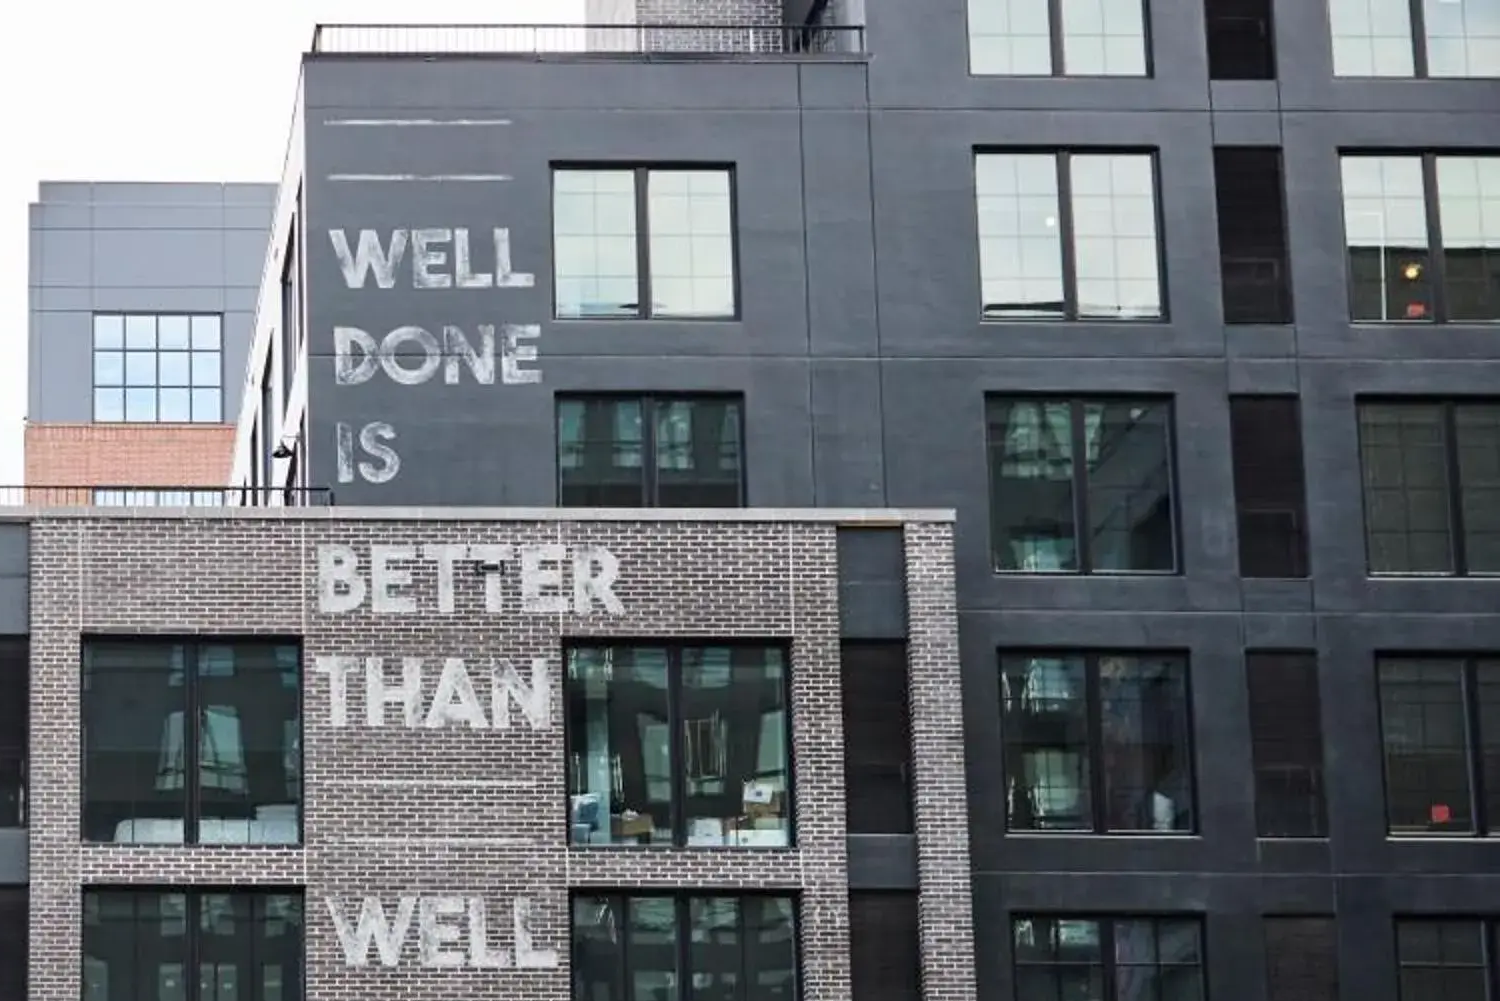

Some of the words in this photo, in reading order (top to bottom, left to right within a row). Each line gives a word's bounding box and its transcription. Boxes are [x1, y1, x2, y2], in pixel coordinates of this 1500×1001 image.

[328, 227, 535, 289] WELL
[333, 323, 543, 385] DONE
[336, 420, 401, 484] IS
[317, 543, 626, 617] BETTER
[314, 656, 553, 730] THAN
[325, 894, 560, 969] WELL
